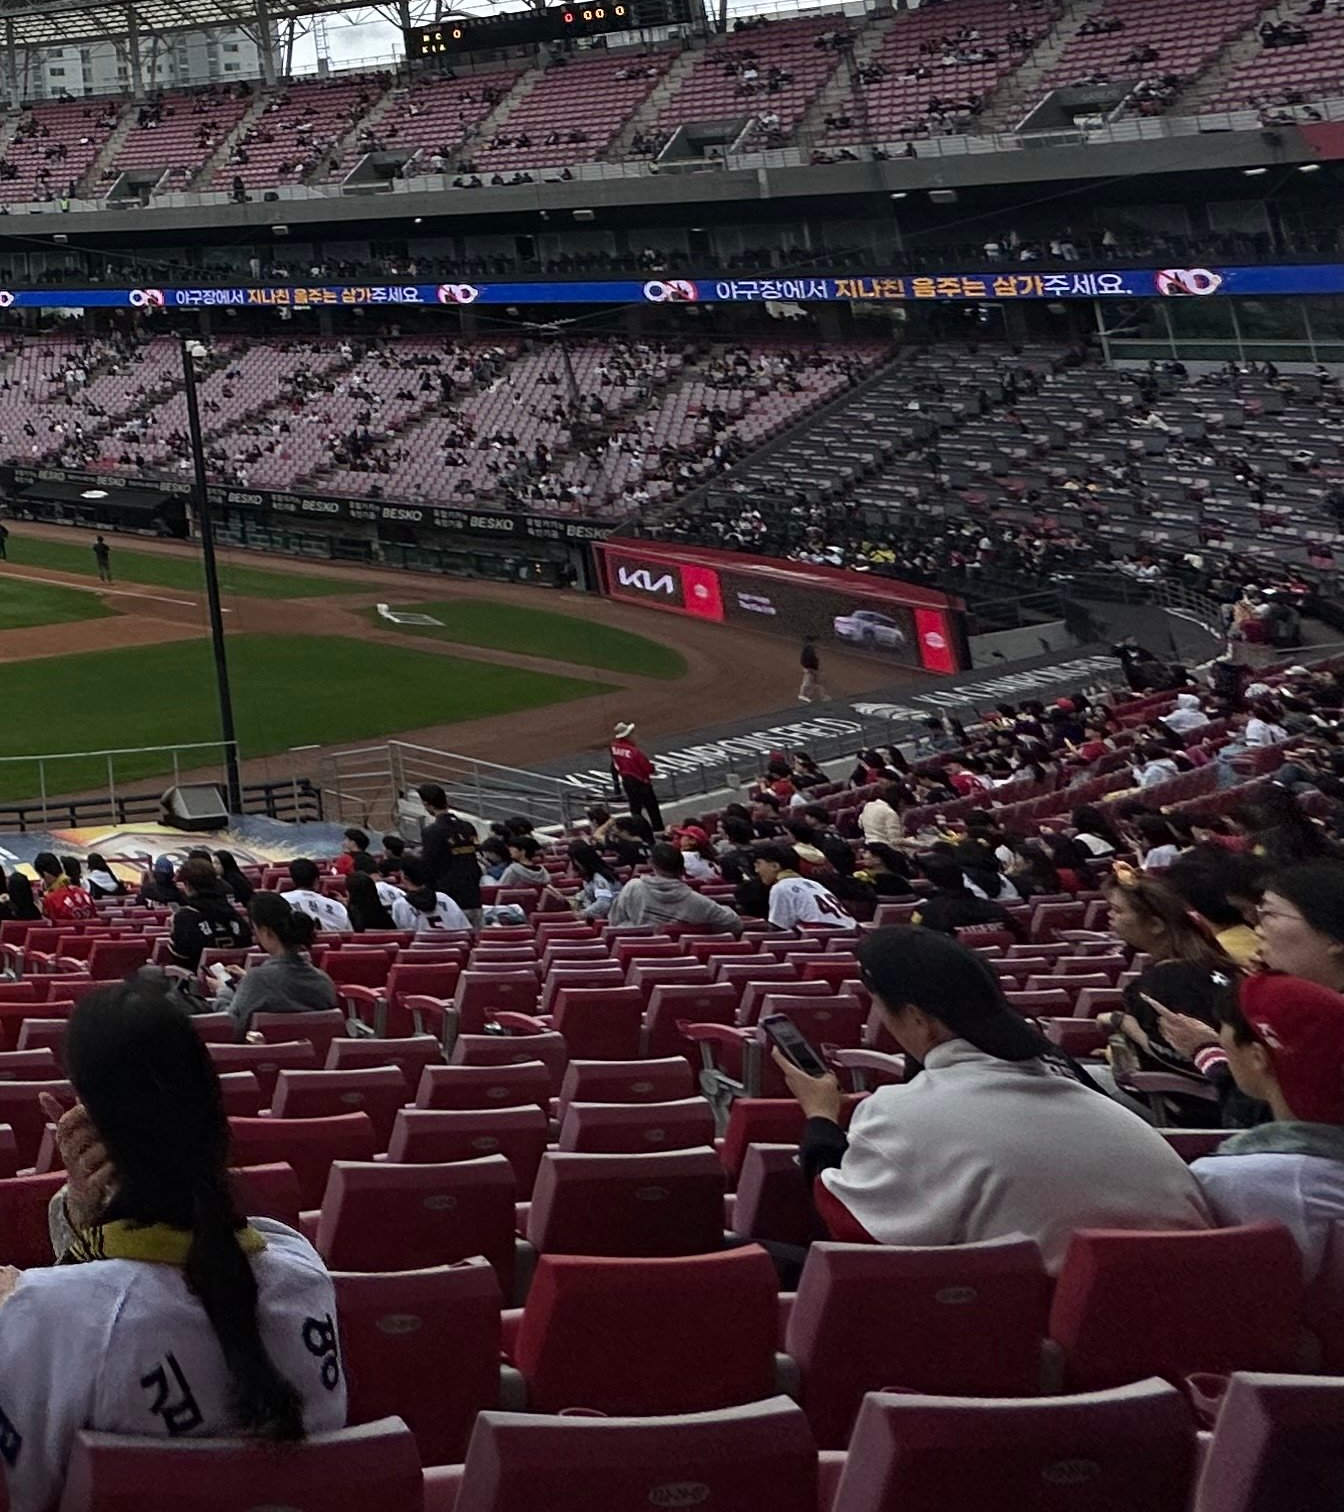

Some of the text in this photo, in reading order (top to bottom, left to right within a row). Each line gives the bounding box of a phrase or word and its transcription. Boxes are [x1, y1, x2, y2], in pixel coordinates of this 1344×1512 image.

[716, 273, 1134, 301] 야구장에서 지나친 음주는 삼가주세요.
[175, 290, 244, 305] 야구장에서
[246, 289, 290, 305] 지나친
[294, 289, 337, 304] 음주는
[382, 508, 423, 521] BESKO
[470, 515, 513, 531] BESKO
[618, 566, 674, 594] KIA
